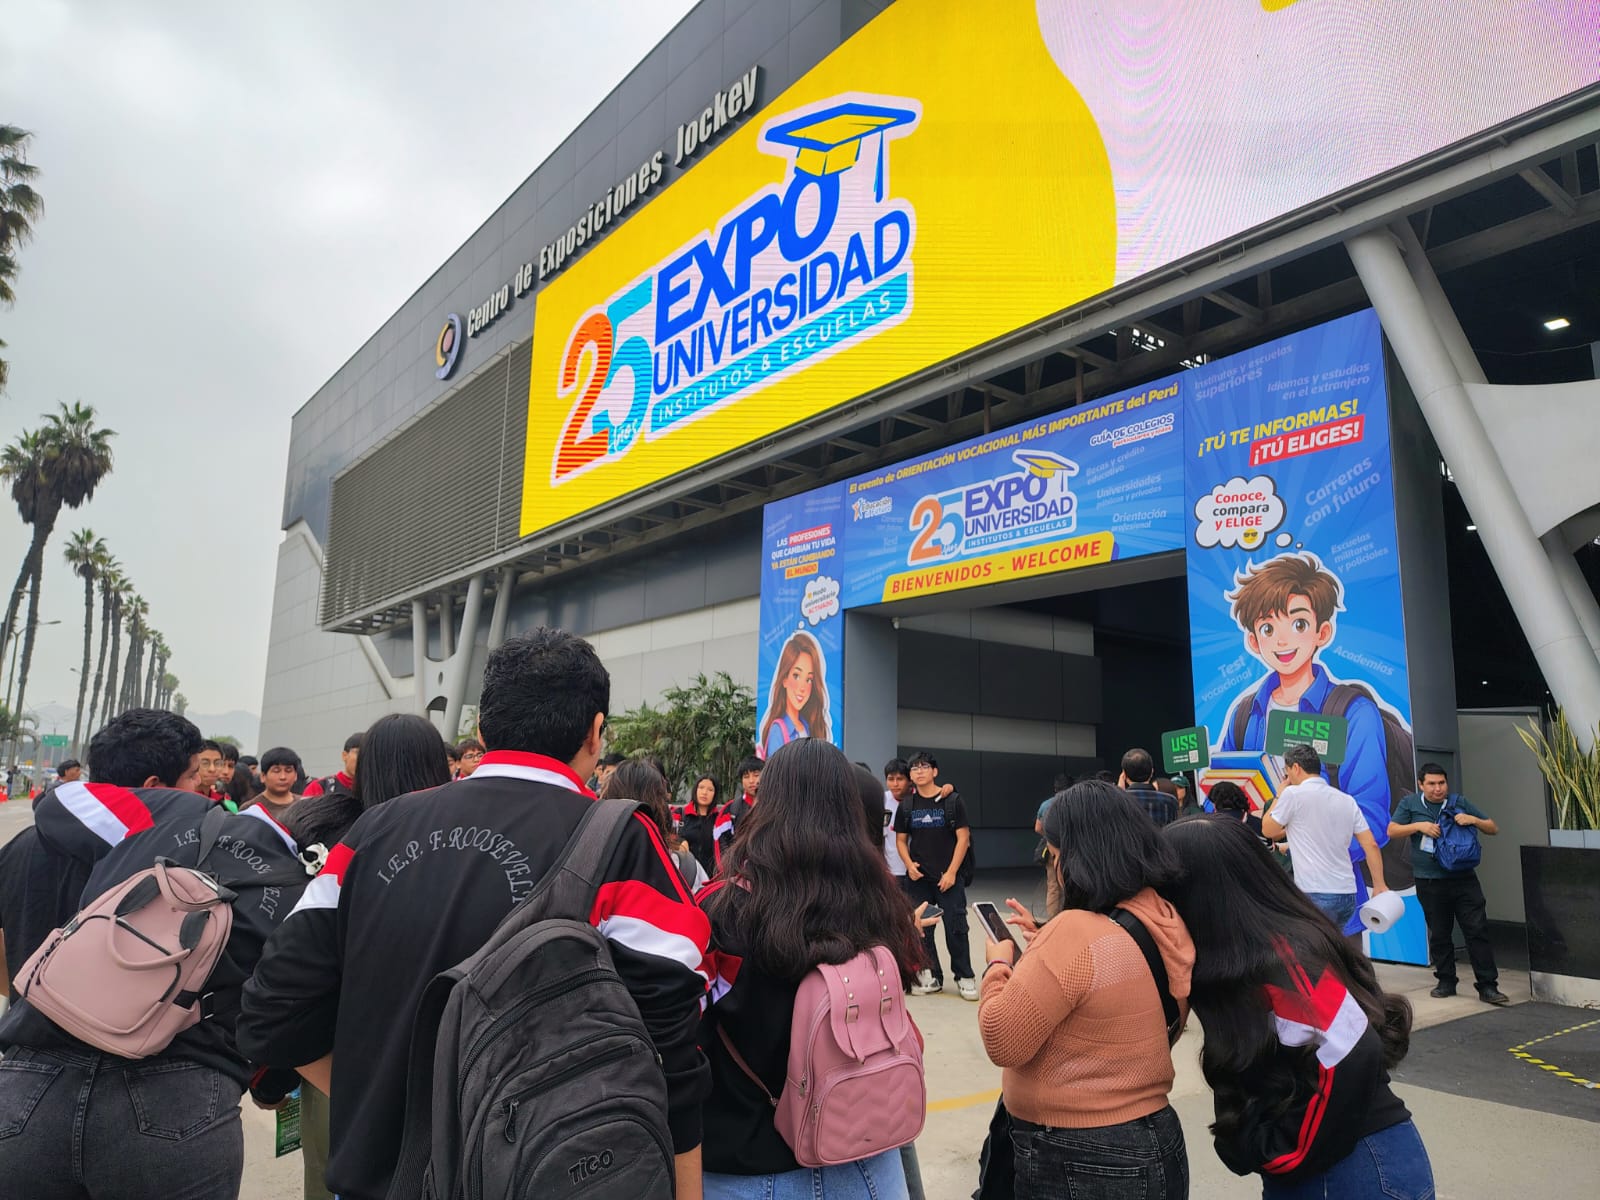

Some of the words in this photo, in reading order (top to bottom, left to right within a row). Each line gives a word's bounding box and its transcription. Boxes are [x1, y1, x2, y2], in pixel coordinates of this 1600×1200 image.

[467, 284, 509, 337] Centro
[514, 263, 533, 298] de
[539, 151, 663, 280] Exposiciones
[674, 65, 759, 166] Jockey
[655, 172, 840, 346] EXPO
[653, 210, 910, 395] UNIVERSIDAD
[658, 363, 753, 422] INSTITUTOS
[760, 354, 771, 372] &
[780, 290, 891, 362] ESCUELAS
[1248, 344, 1294, 369] escuelas
[555, 276, 653, 479] 25
[1195, 368, 1263, 401] superiores
[1267, 376, 1310, 393] Idiomas
[1312, 374, 1319, 384] y
[1321, 362, 1371, 380] estudios
[1282, 391, 1296, 400] en
[1298, 386, 1309, 397] el
[1311, 375, 1370, 394] extranjero
[849, 482, 857, 494] El
[858, 477, 884, 491] evento
[885, 473, 895, 484] de
[896, 452, 956, 480] ORIENTACIÓN
[957, 433, 1020, 462] VOCACIONAL
[1022, 423, 1047, 441] MÁS
[1048, 399, 1125, 433] IMPORTANTE
[1126, 394, 1146, 410] del
[1148, 382, 1179, 403] Perú
[1090, 429, 1112, 446] GUÍA
[1113, 427, 1126, 438] DE
[1126, 414, 1174, 435] COLEGIOS
[1198, 430, 1226, 458] ¡TÚ
[1230, 427, 1251, 446] TE
[1253, 398, 1359, 440] INFORMAS!
[1253, 436, 1285, 465] ¡TÚ
[1287, 421, 1360, 453] ELIGES!
[965, 473, 1048, 519] EXPO
[1096, 474, 1162, 498] Universidades
[1215, 490, 1267, 504] Conoce,
[1305, 457, 1373, 507] Carreras
[1112, 508, 1167, 522] Orientación
[1212, 503, 1270, 519] compara
[1304, 503, 1331, 528] con
[1332, 471, 1382, 514] futuro
[910, 491, 964, 562] 25
[965, 496, 1074, 537] UNIVERSIDAD
[1215, 520, 1223, 531] y
[1225, 516, 1263, 528] ELIGE
[771, 549, 784, 560] QUE
[784, 543, 811, 556] CAMBIAN
[812, 541, 820, 550] TU
[820, 537, 836, 548] VIDA
[776, 537, 788, 547] LAS
[967, 531, 1013, 548] INSTITUTOS
[1015, 529, 1022, 537] &
[1024, 519, 1067, 536] ESCUELAS
[891, 562, 992, 594] BIENVENIDOS
[1011, 540, 1102, 571] WELCOME
[1218, 653, 1246, 679] Test
[1334, 645, 1395, 677] Academias
[1201, 668, 1253, 703] vocacional
[1171, 733, 1198, 752] USS
[1284, 717, 1330, 739] USS
